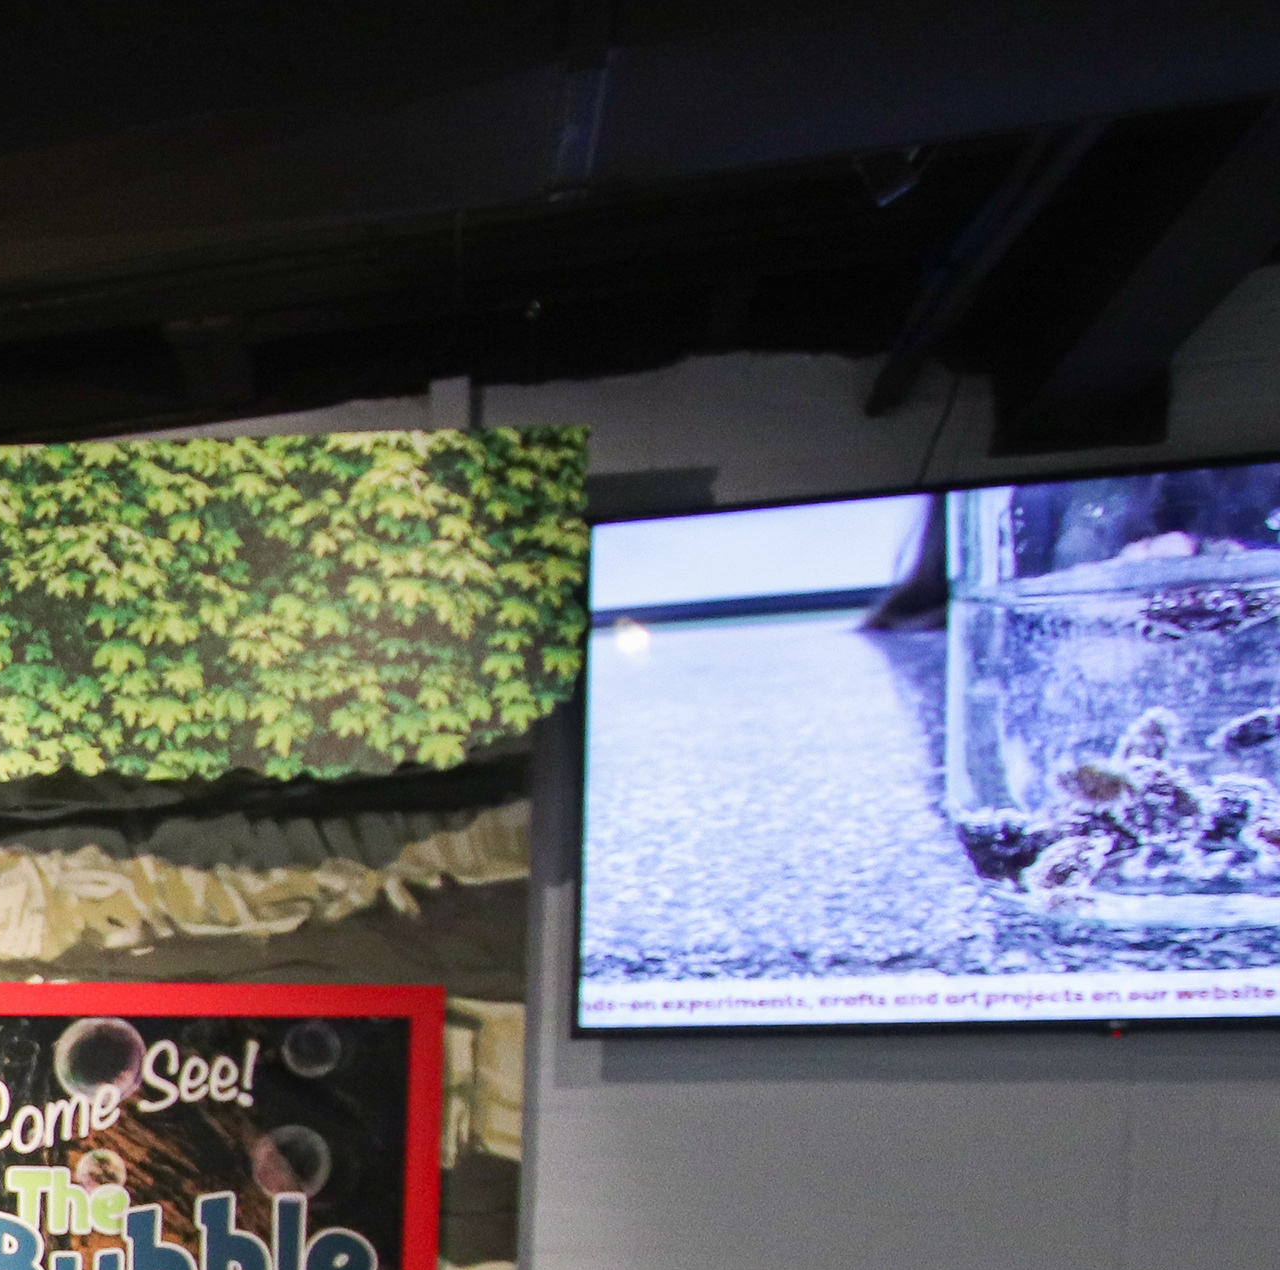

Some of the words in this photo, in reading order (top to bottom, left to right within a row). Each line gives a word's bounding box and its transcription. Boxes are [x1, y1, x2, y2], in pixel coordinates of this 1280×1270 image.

[819, 991, 886, 1006] crafts
[894, 992, 938, 1006] and
[945, 991, 978, 1005] art
[985, 988, 1084, 1009] projects
[1092, 990, 1121, 1003] on
[1128, 990, 1169, 1002] our
[139, 1038, 261, 1113] See!
[6, 1166, 131, 1235] The
